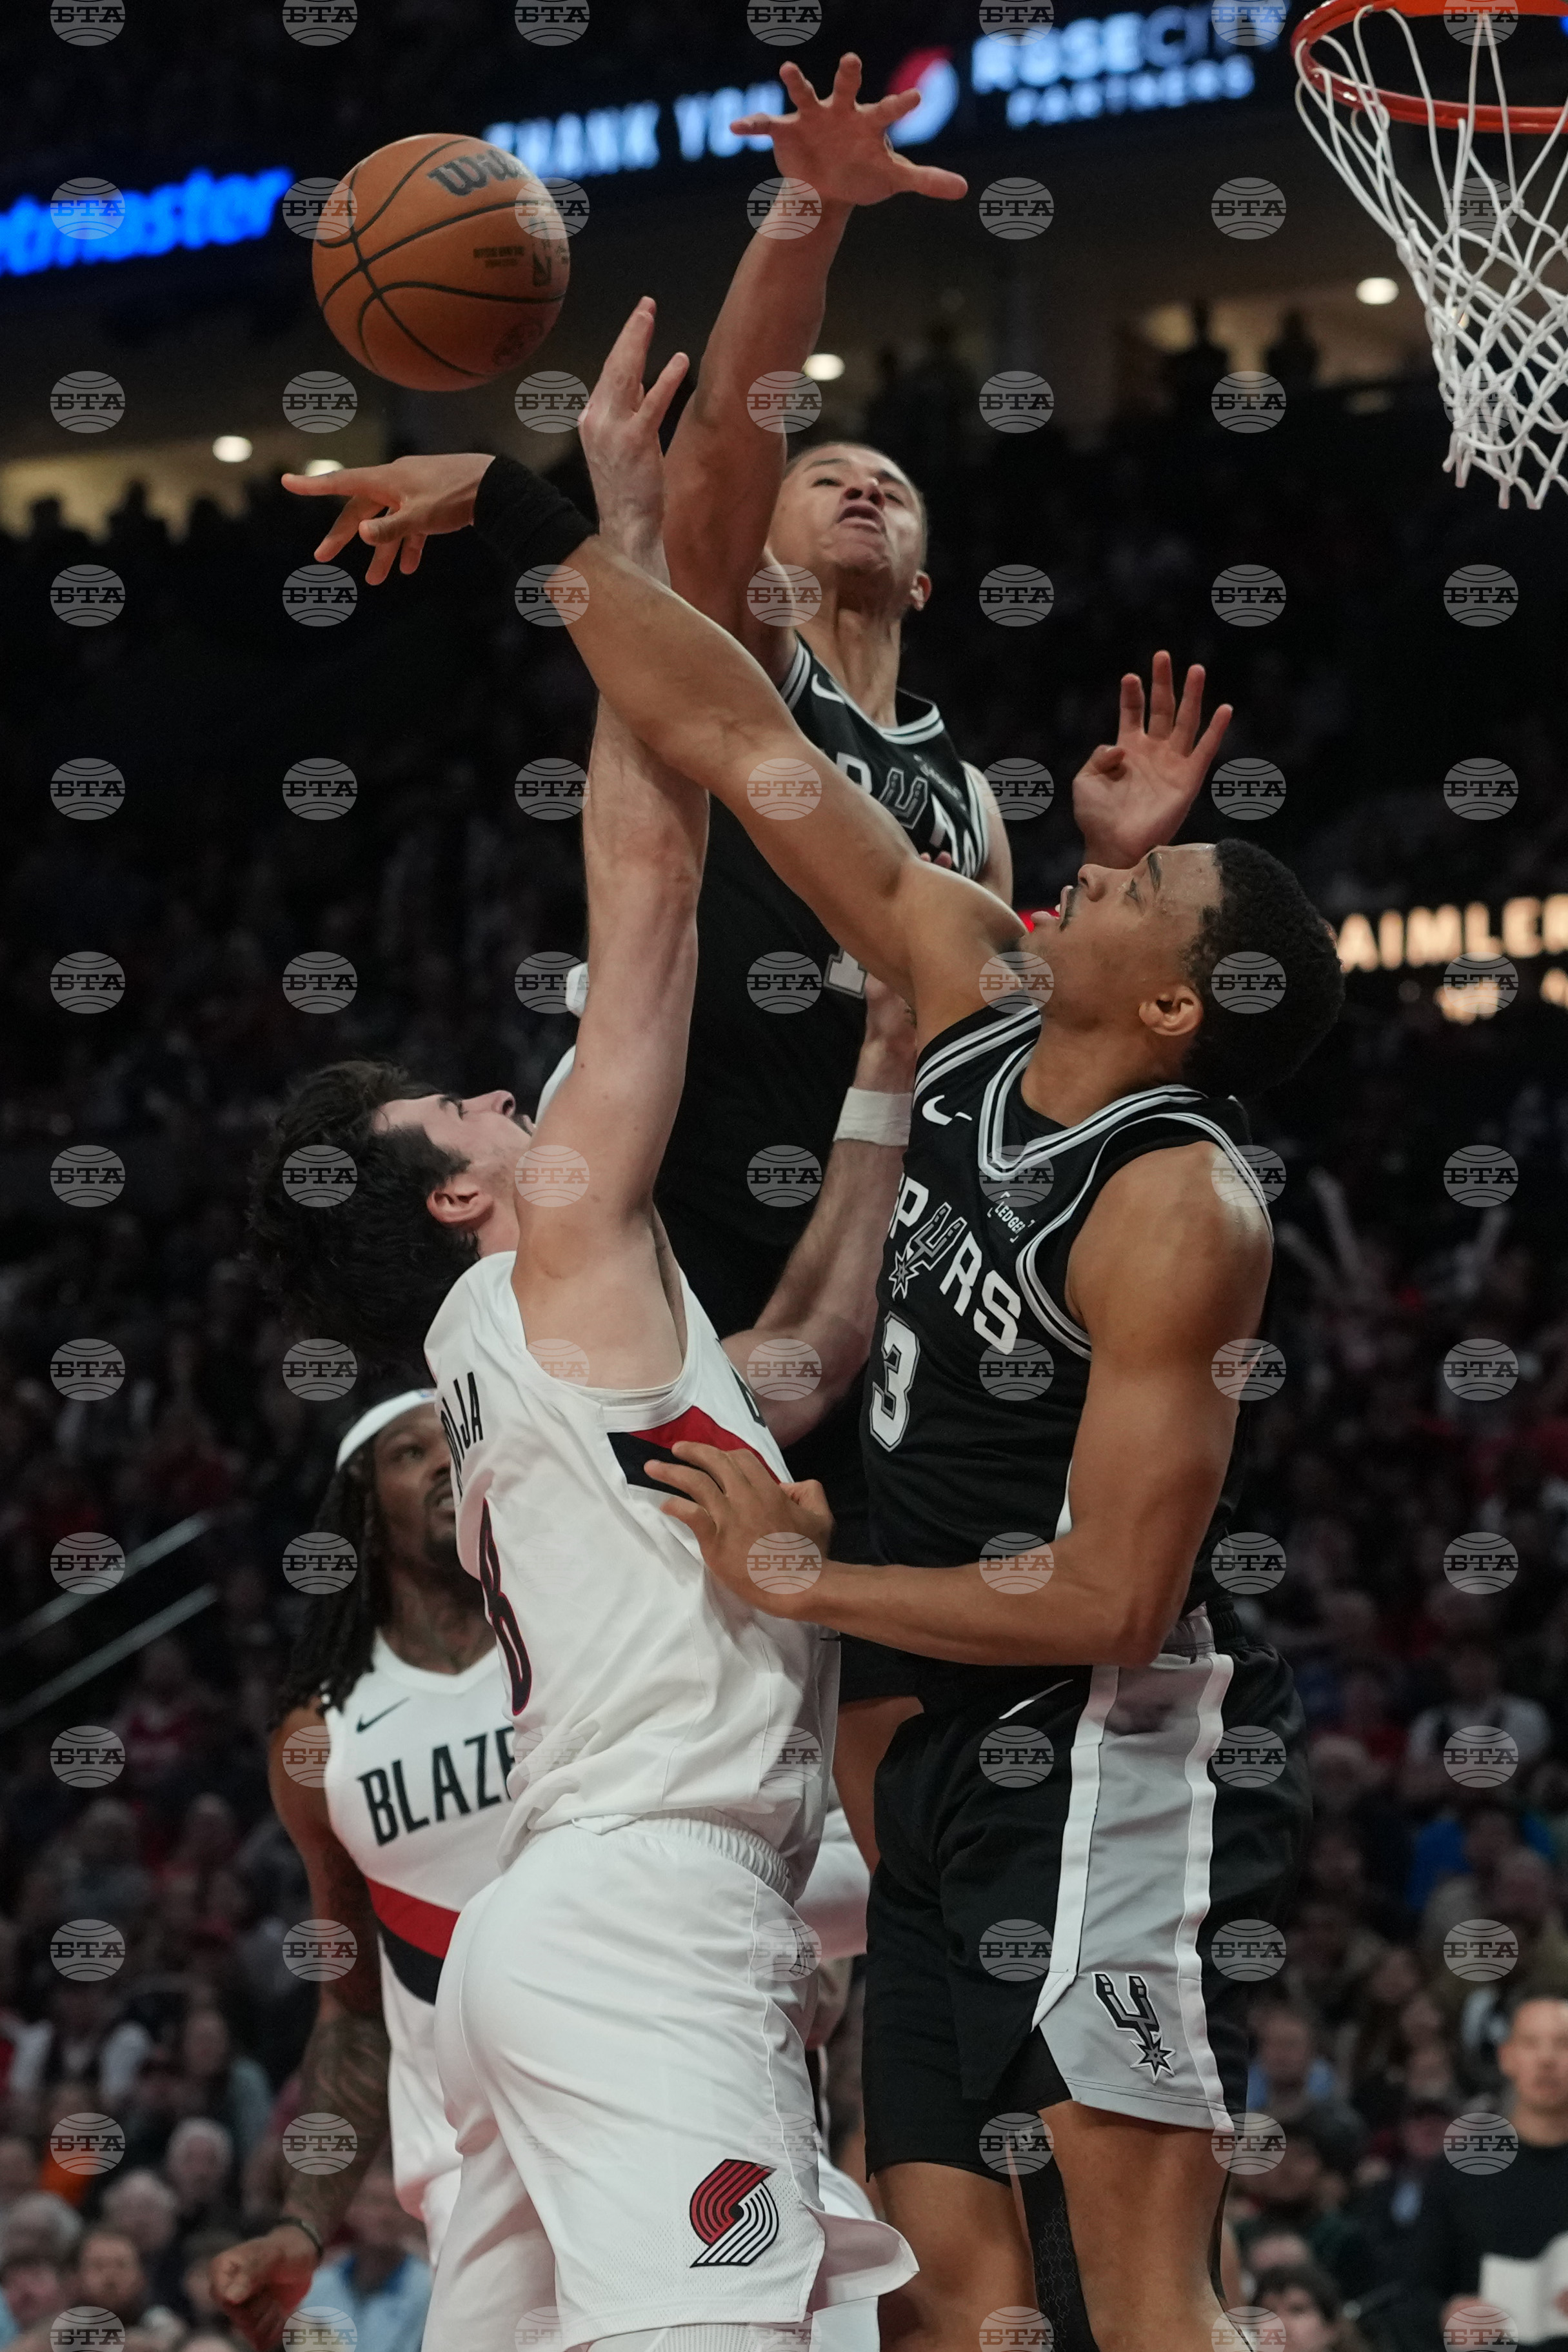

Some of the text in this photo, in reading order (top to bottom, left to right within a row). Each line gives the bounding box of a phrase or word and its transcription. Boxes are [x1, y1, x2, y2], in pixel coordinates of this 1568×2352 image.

[426, 148, 532, 197] Wil
[888, 1171, 1022, 1355] PURS
[869, 1310, 921, 1452] 3
